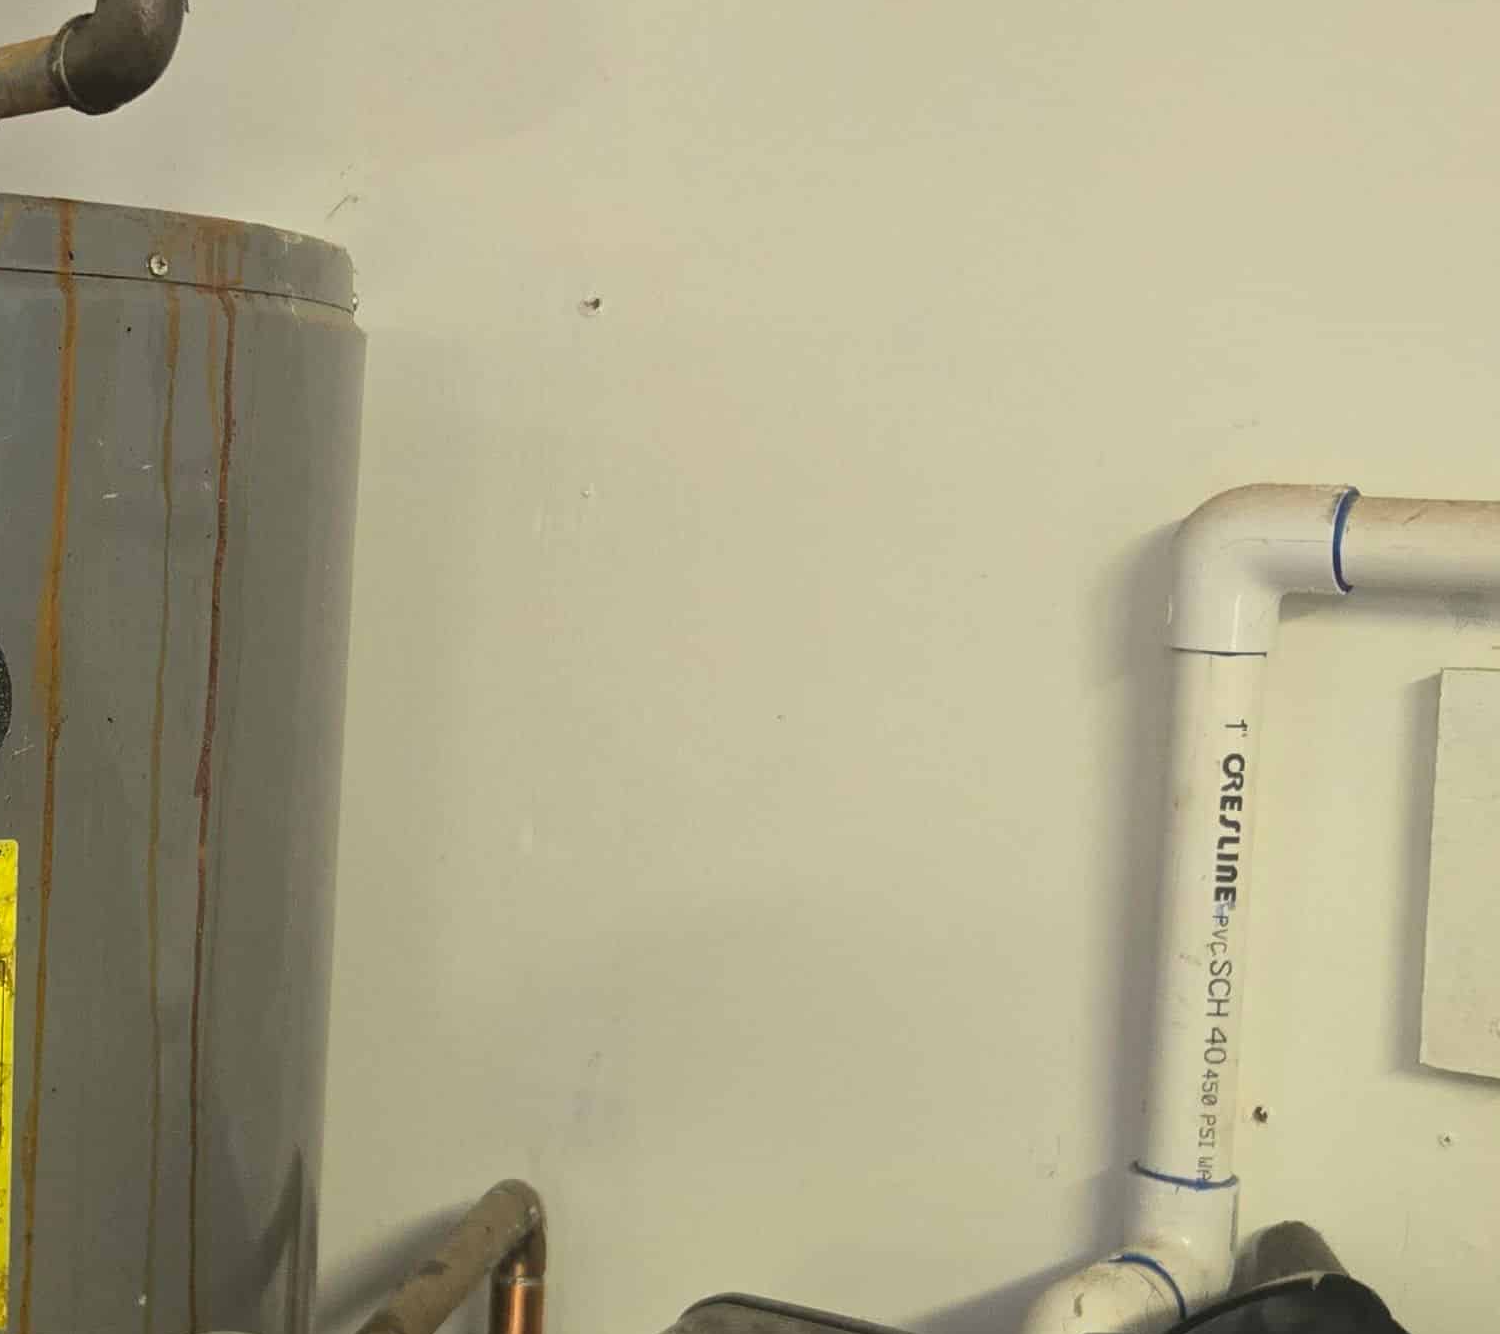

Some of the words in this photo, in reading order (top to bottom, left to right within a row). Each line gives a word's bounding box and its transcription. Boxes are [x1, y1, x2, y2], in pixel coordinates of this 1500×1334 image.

[1214, 753, 1246, 903] CRESLINE
[1205, 959, 1233, 1019] SCH
[1203, 1026, 1228, 1066] 40
[1200, 1068, 1219, 1107] 450
[1198, 1115, 1217, 1148] PSI
